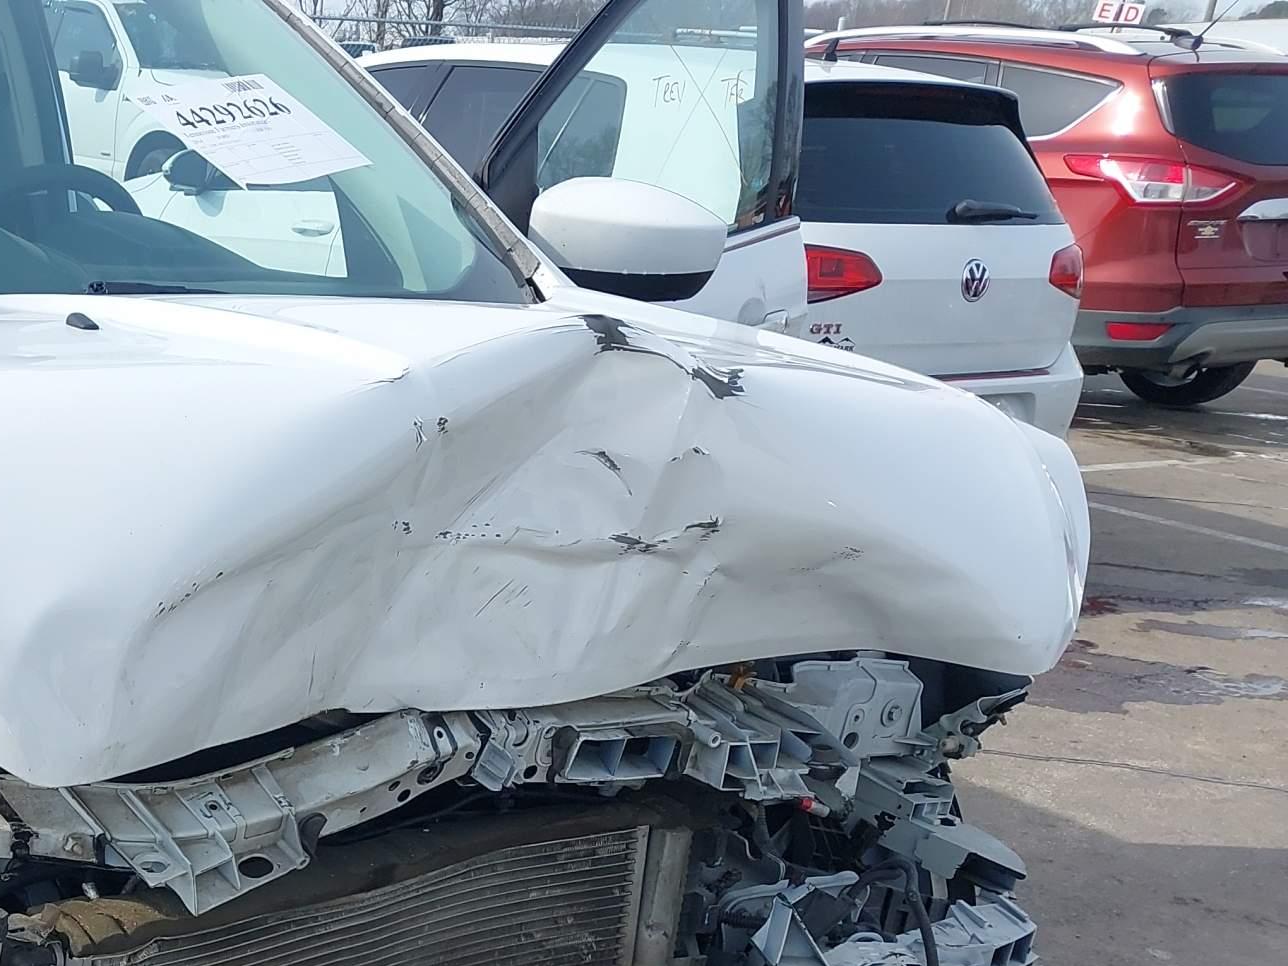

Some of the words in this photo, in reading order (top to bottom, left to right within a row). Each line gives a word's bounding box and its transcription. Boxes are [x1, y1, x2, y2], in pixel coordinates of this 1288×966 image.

[1098, 3, 1114, 19] E
[1124, 6, 1140, 22] D
[175, 96, 292, 129] 44292626
[810, 323, 842, 335] GTI
